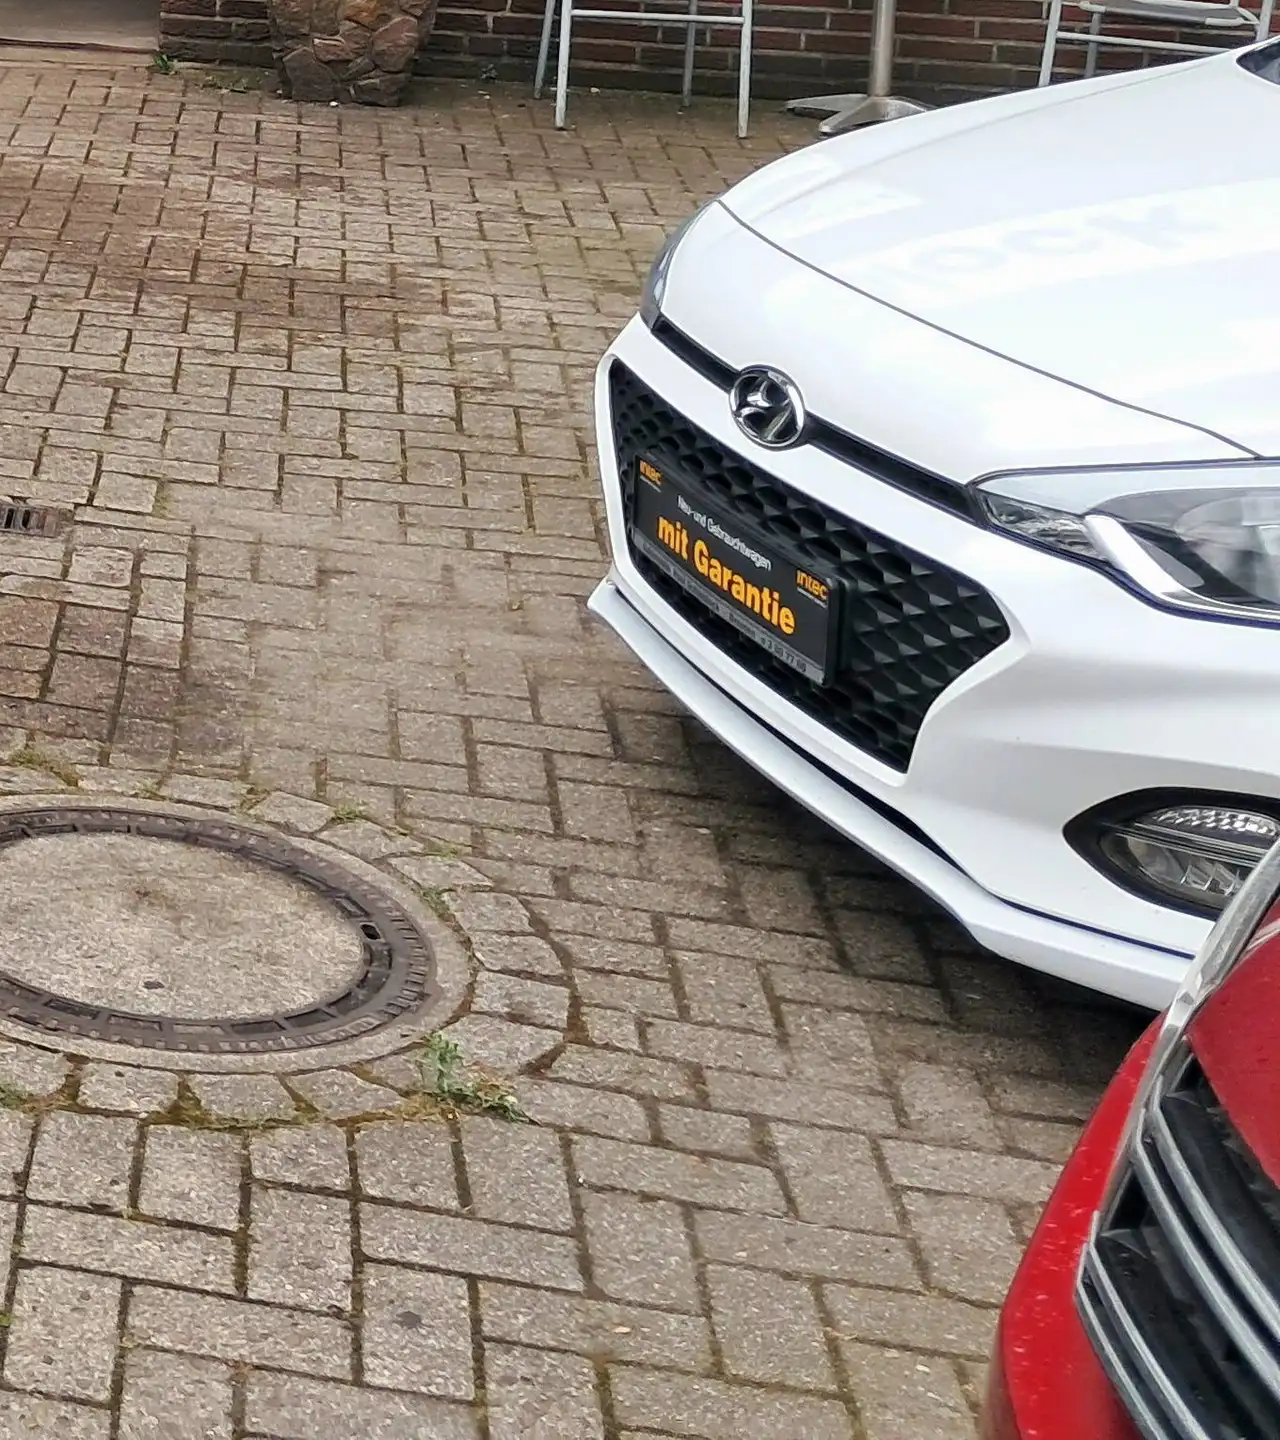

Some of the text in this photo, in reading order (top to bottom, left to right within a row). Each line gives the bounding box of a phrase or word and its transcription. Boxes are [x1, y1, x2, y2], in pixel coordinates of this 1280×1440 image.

[657, 515, 689, 561] mit
[693, 539, 797, 636] Garantie
[796, 570, 830, 602] intec
